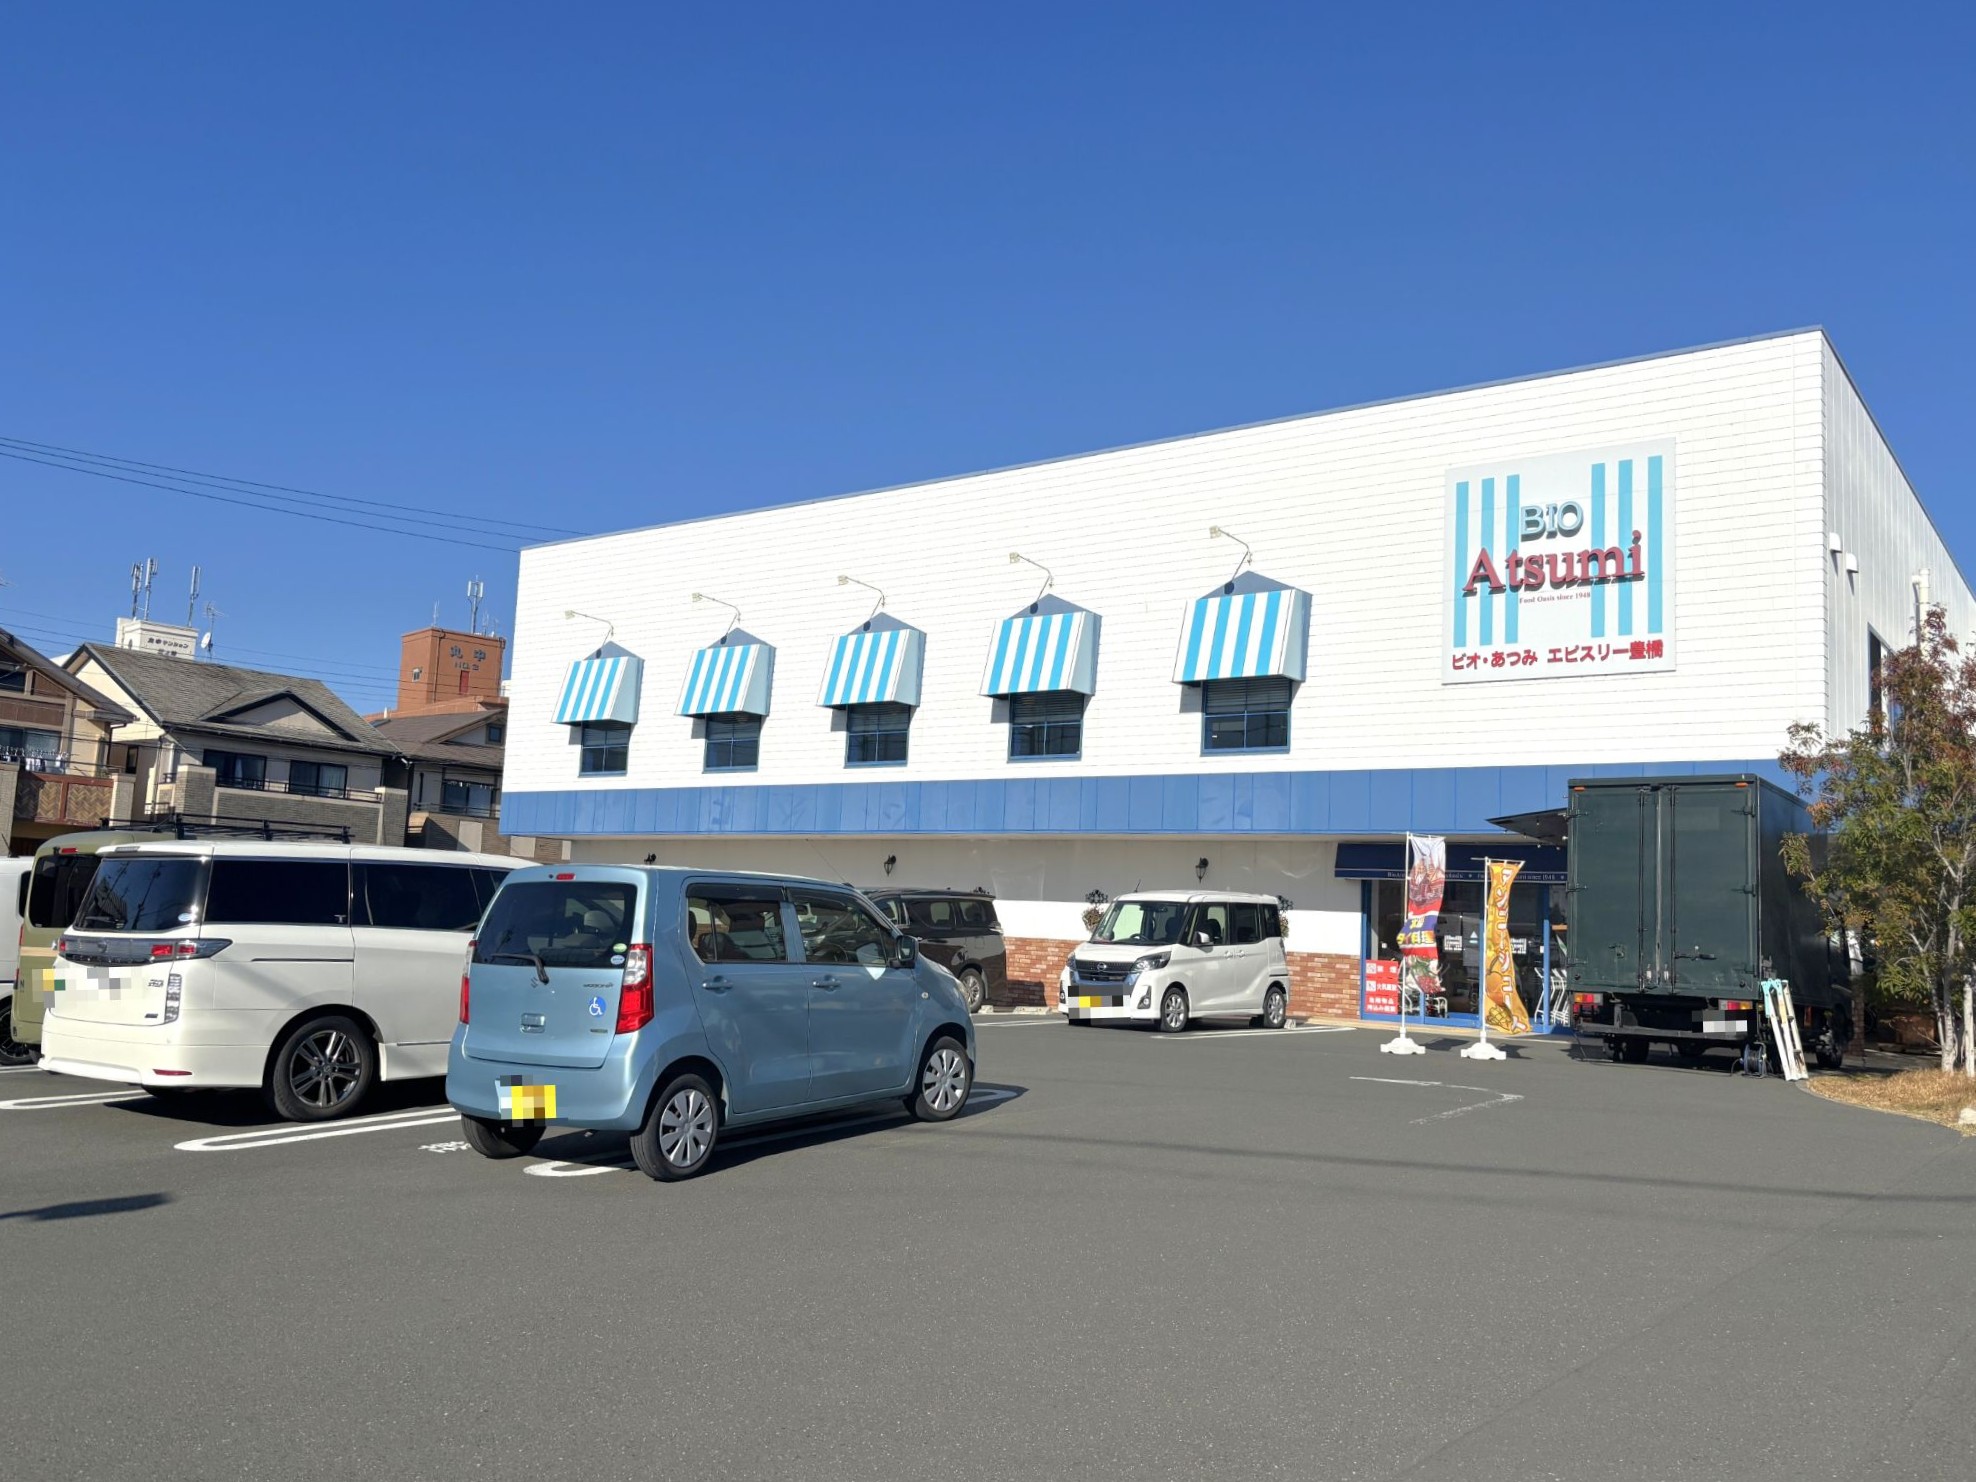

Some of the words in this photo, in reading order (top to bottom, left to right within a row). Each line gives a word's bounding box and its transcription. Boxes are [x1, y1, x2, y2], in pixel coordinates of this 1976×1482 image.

[1520, 501, 1584, 541] BIO
[1462, 530, 1645, 597] Atsumi
[1451, 649, 1538, 670] ビオ・あつみ
[1547, 639, 1664, 663] エピスリー豊橋
